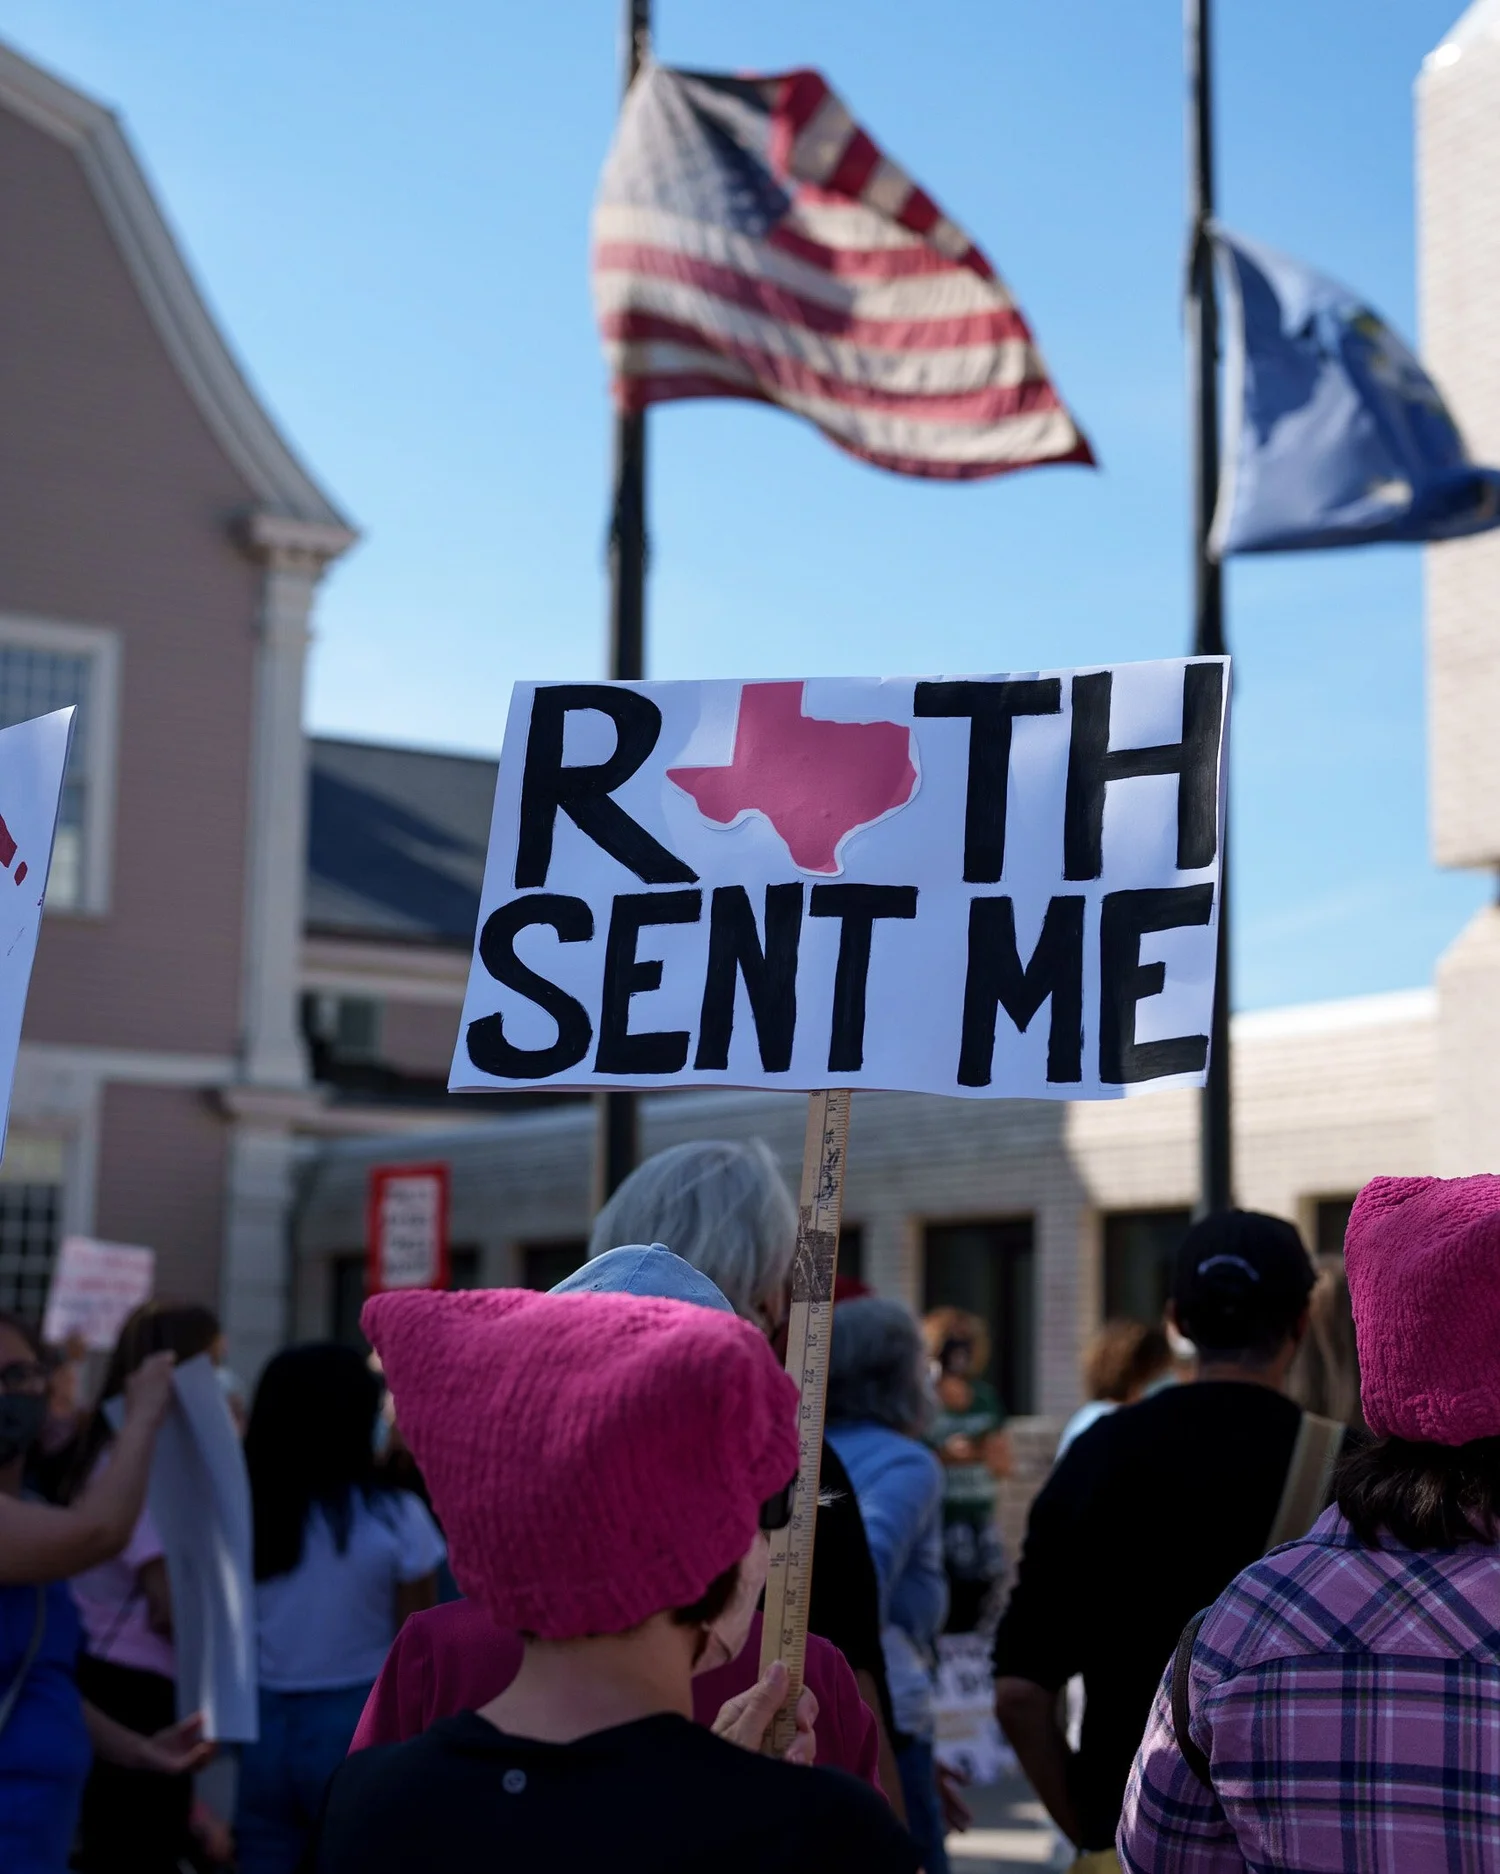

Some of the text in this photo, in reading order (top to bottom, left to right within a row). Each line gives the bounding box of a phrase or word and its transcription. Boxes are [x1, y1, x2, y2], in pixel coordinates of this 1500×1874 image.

[514, 663, 1224, 890] RTH
[466, 882, 1214, 1087] SENT ME
[807, 1333, 818, 1347] 21
[804, 1369, 814, 1384] 22
[802, 1404, 811, 1419] 23
[799, 1440, 808, 1456] 24
[796, 1477, 805, 1492] 25
[792, 1514, 803, 1530] 26
[789, 1551, 799, 1567] 27
[785, 1589, 796, 1606] 28
[782, 1628, 793, 1645] 29
